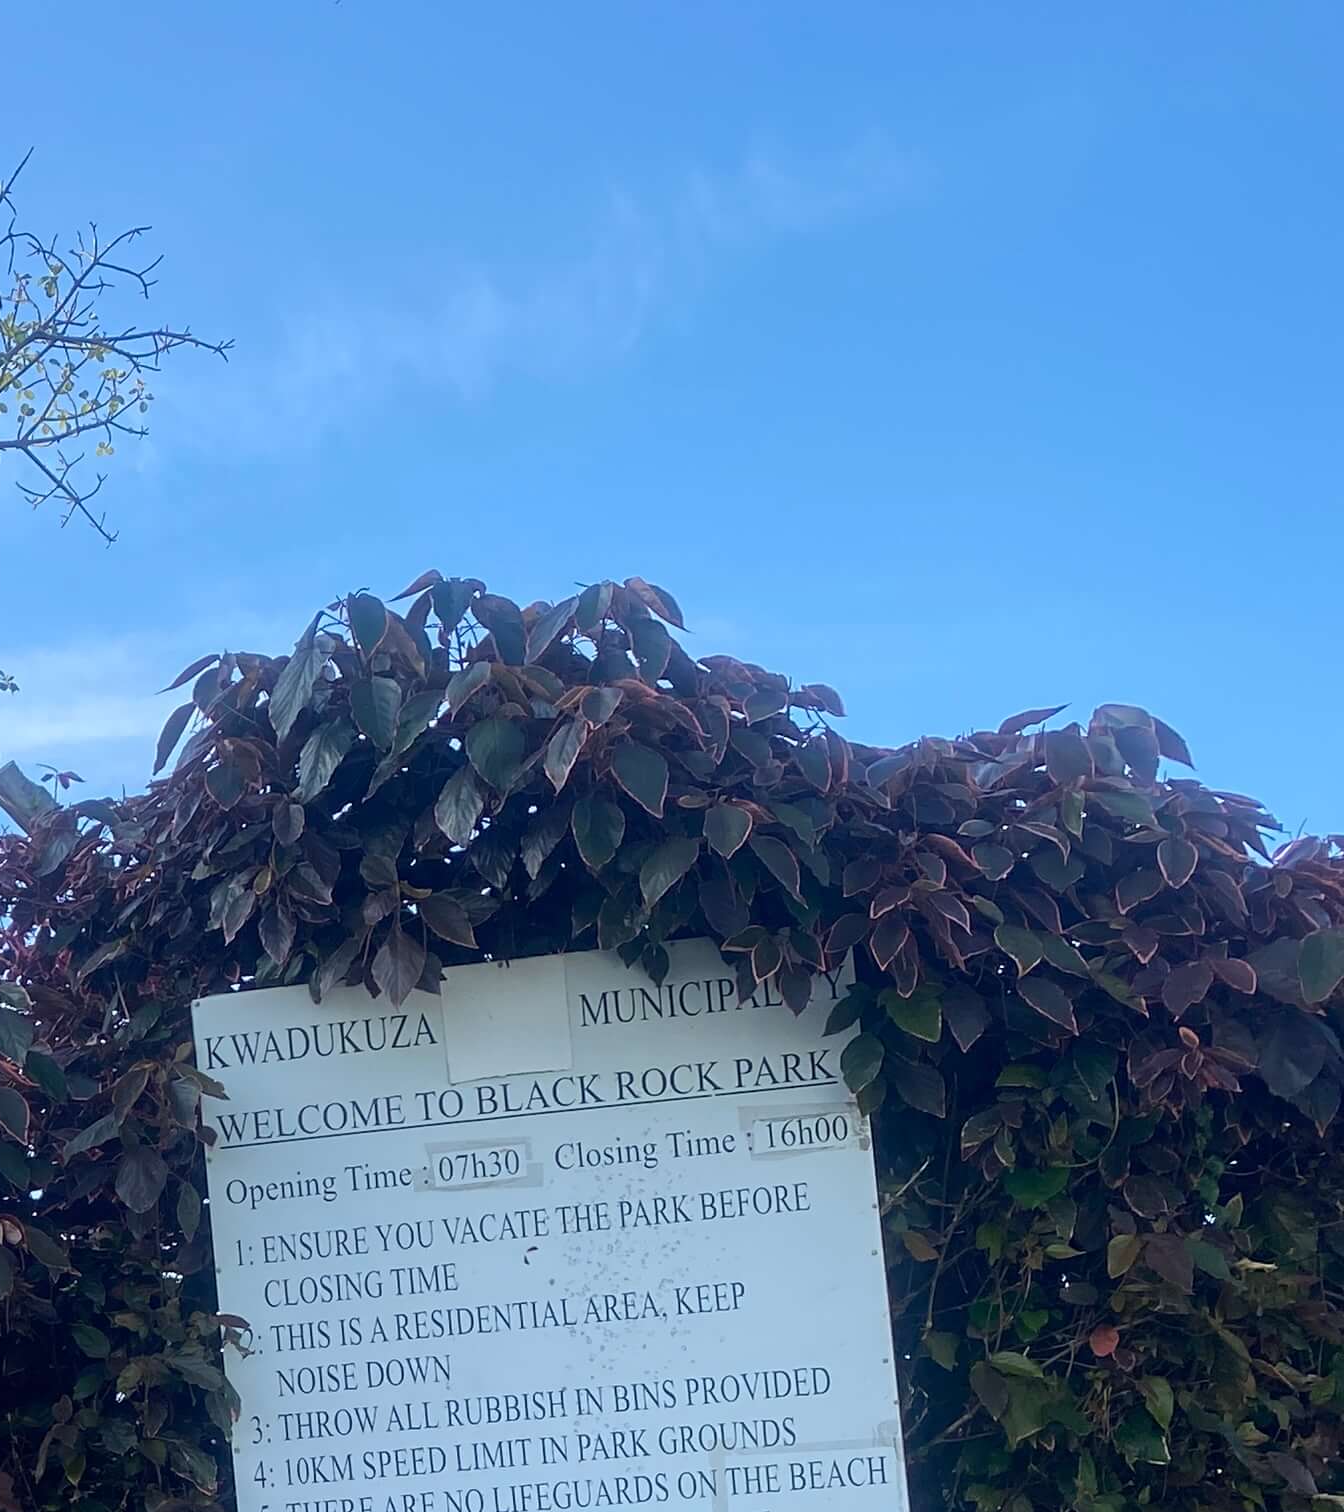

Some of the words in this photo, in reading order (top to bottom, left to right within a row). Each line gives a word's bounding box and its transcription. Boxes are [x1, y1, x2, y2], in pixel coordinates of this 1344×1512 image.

[204, 1013, 438, 1069] KWADUKUZA
[216, 1095, 405, 1142] WELCOME
[415, 1090, 463, 1120] TO
[471, 1071, 605, 1115] BLACK
[615, 1062, 724, 1100] ROCK
[734, 1050, 836, 1088] PARK
[226, 1171, 337, 1210] Opening
[344, 1164, 411, 1191] Time
[439, 1150, 519, 1185] 07h30
[555, 1137, 658, 1169] Closing
[665, 1130, 735, 1158] Time
[760, 1113, 847, 1150] 16h00
[237, 1240, 253, 1266] 1:
[262, 1227, 368, 1263] ENSURE
[375, 1220, 433, 1251] YOU
[442, 1208, 549, 1252] VACATE
[555, 1203, 610, 1234] THE
[619, 1195, 694, 1228] PARK
[699, 1183, 810, 1220] BEFORE
[265, 1271, 382, 1307] CLOSING
[390, 1263, 458, 1295] TIME
[270, 1320, 330, 1352] THIS
[339, 1318, 362, 1346] IS
[370, 1317, 388, 1343] A
[394, 1299, 577, 1340] RESIDENTIAL
[675, 1282, 744, 1315] KEEP
[251, 1416, 271, 1444] 3:
[278, 1406, 378, 1440] THROW
[386, 1402, 439, 1432] ALL
[445, 1387, 567, 1426] RUBBISH
[575, 1387, 603, 1415] IN
[613, 1380, 676, 1412] BINS
[686, 1368, 830, 1406] PROVIDED
[276, 1363, 358, 1396] NOISE
[366, 1355, 450, 1389] DOWN
[254, 1461, 274, 1488] 4:
[286, 1454, 354, 1485] 10KM
[363, 1447, 446, 1479] SPEED
[455, 1438, 531, 1471] LIMIT
[540, 1436, 568, 1464] IN
[576, 1429, 650, 1463] PARK
[659, 1417, 796, 1454] GROUNDS
[678, 1469, 717, 1499] ON
[725, 1464, 780, 1495] THE
[789, 1456, 887, 1491] BEACH
